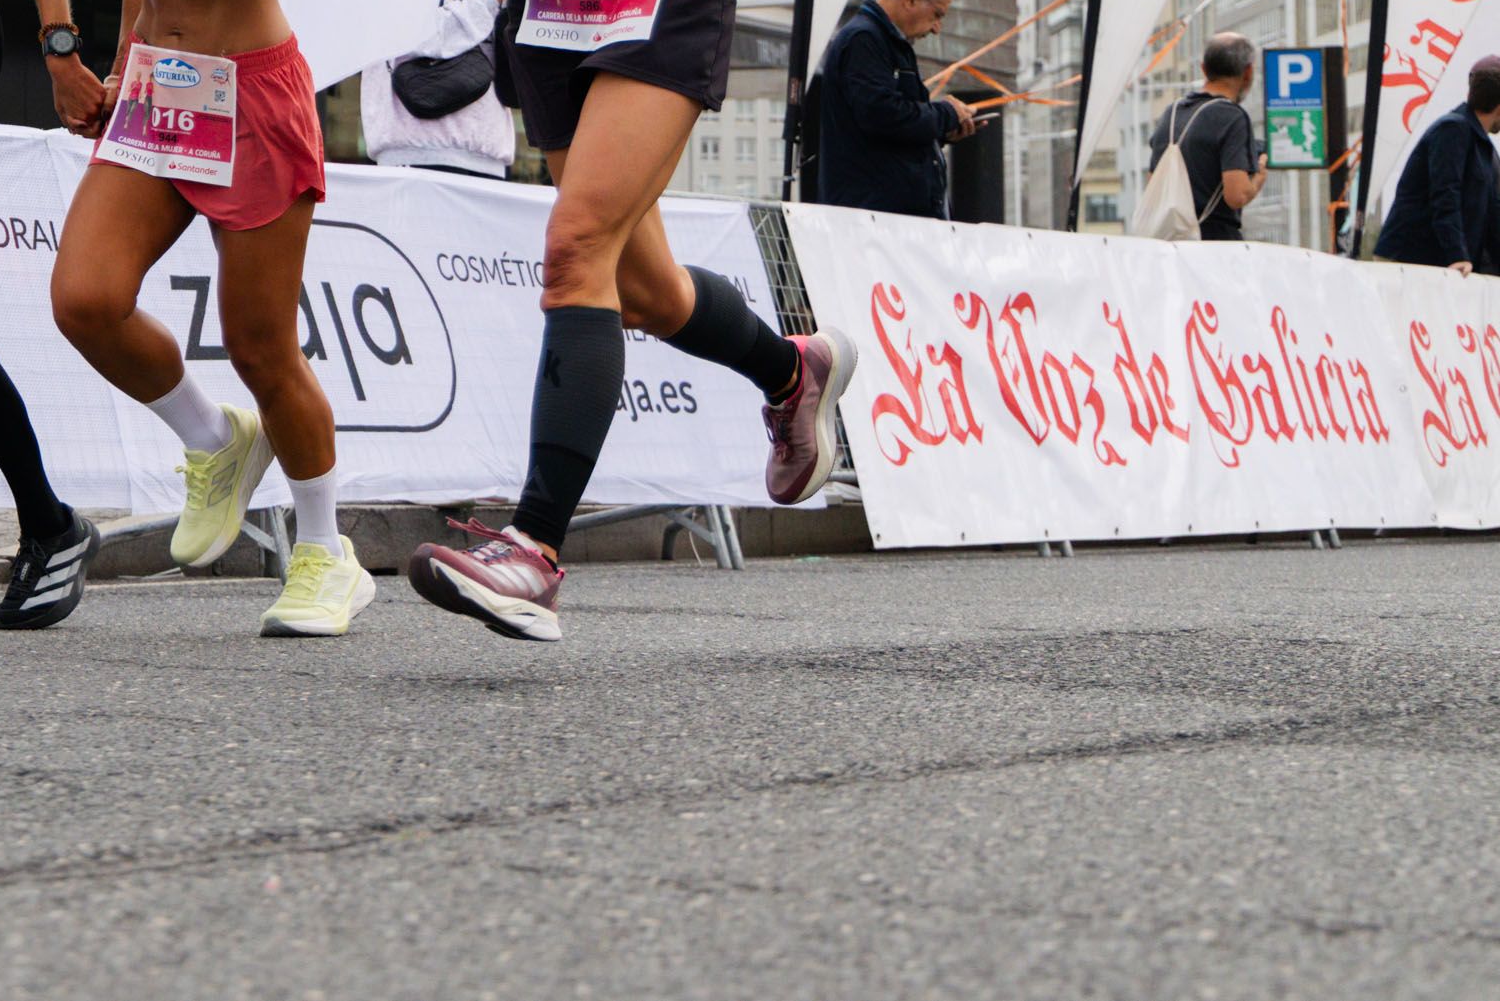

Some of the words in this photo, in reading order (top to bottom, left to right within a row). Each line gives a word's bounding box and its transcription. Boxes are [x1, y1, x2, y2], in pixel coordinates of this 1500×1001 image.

[535, 27, 579, 41] OYSHO
[1277, 53, 1314, 98] P
[151, 107, 195, 131] 016
[117, 135, 146, 150] CARRERA
[114, 148, 156, 168] OYSHO
[177, 163, 218, 177] Santander
[871, 281, 984, 466] La
[953, 290, 1127, 467] Voz
[1102, 300, 1190, 446] de
[1185, 300, 1390, 468] Galicia
[1409, 319, 1488, 468] La
